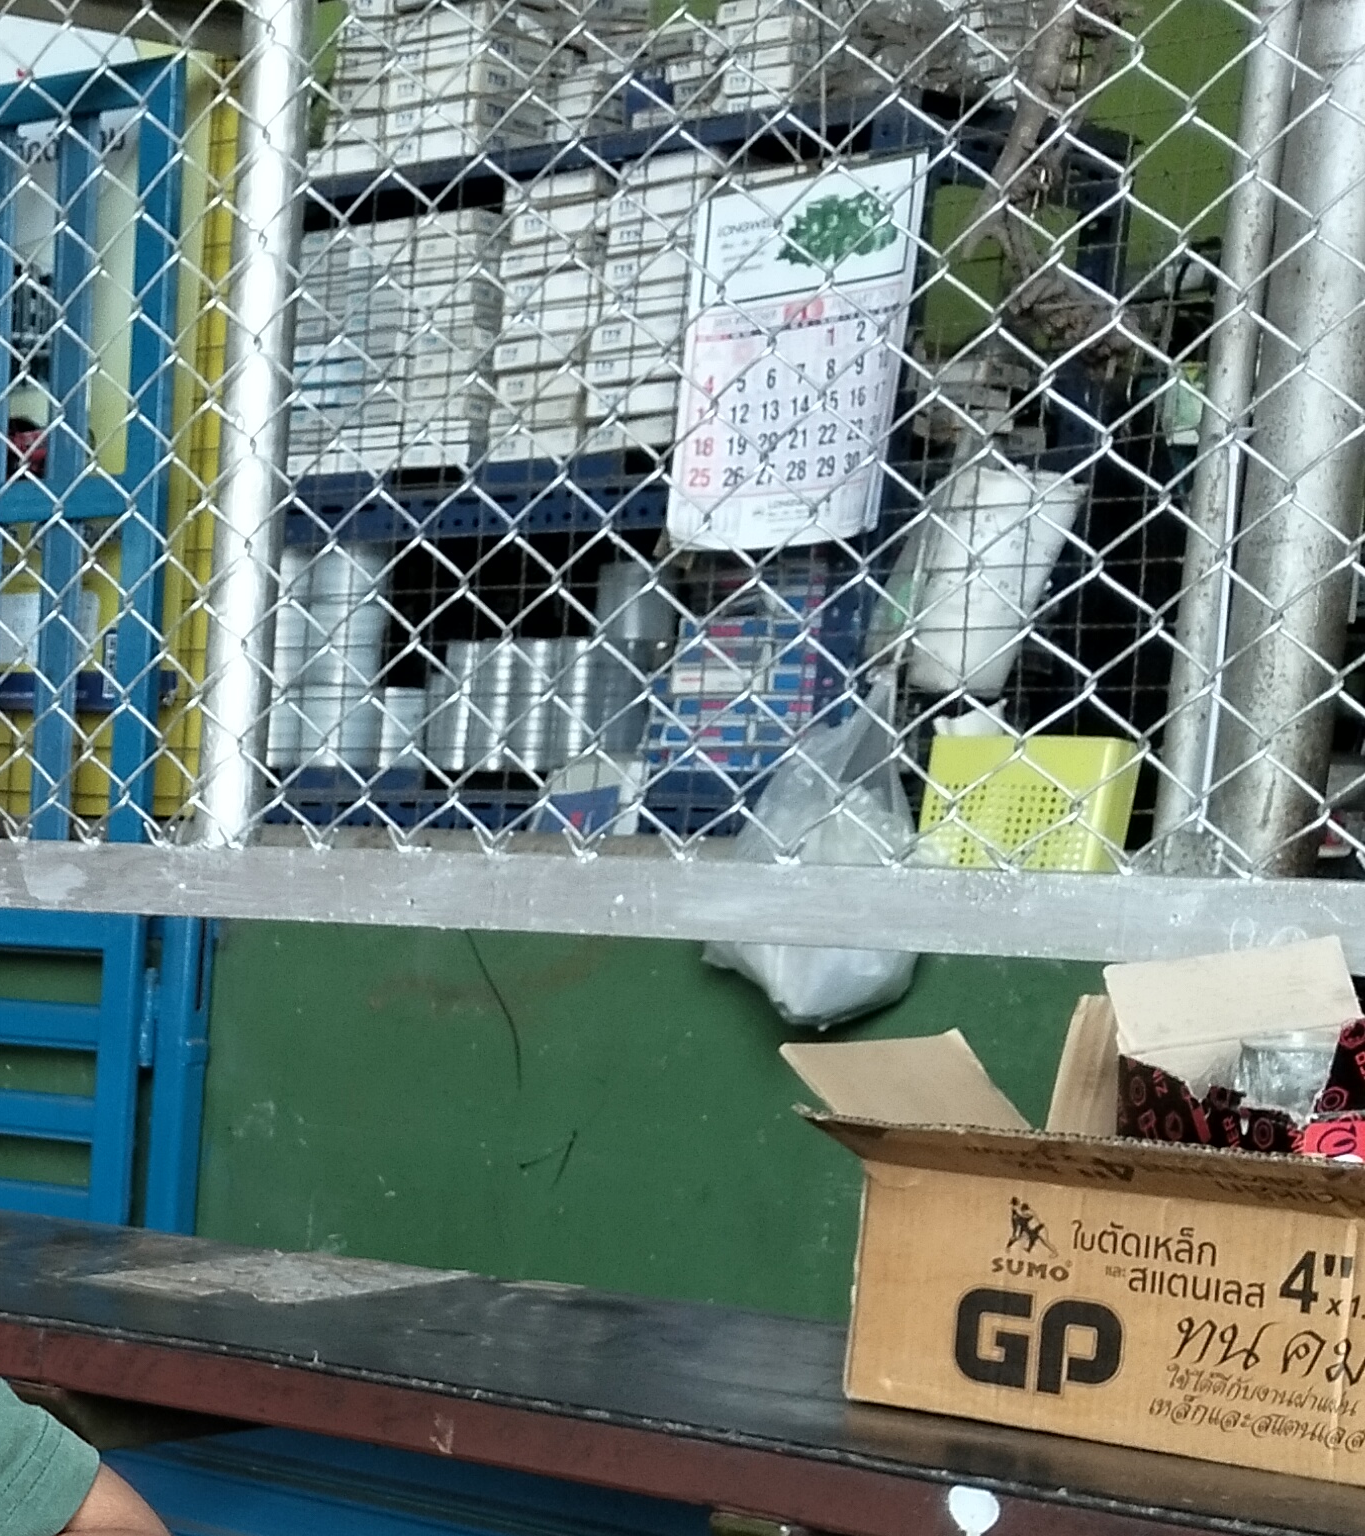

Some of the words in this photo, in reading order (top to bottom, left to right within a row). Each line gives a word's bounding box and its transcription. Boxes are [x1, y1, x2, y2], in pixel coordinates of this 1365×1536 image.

[826, 327, 836, 346] 1
[856, 320, 866, 342] 2
[766, 368, 777, 389] 6
[796, 362, 806, 384] 7
[826, 358, 836, 380] 8
[854, 354, 865, 376] 9
[730, 403, 750, 424] 12
[762, 399, 780, 421] 13
[791, 395, 810, 416] 14
[850, 386, 866, 408] 16
[694, 437, 714, 457] 18
[728, 435, 747, 456] 19
[789, 427, 808, 449] 21
[817, 423, 838, 445] 22
[689, 467, 710, 488] 25
[722, 466, 744, 488] 26
[786, 459, 807, 482] 28
[816, 455, 836, 478] 29
[843, 450, 861, 475] 30
[1070, 1219, 1218, 1268] ใบตัดเหล็ก
[991, 1257, 1070, 1282] SUMO
[1127, 1266, 1266, 1309] สแตนเลส
[1278, 1250, 1354, 1315] 4"
[954, 1287, 1125, 1396] GP
[1172, 1316, 1281, 1371] ทน
